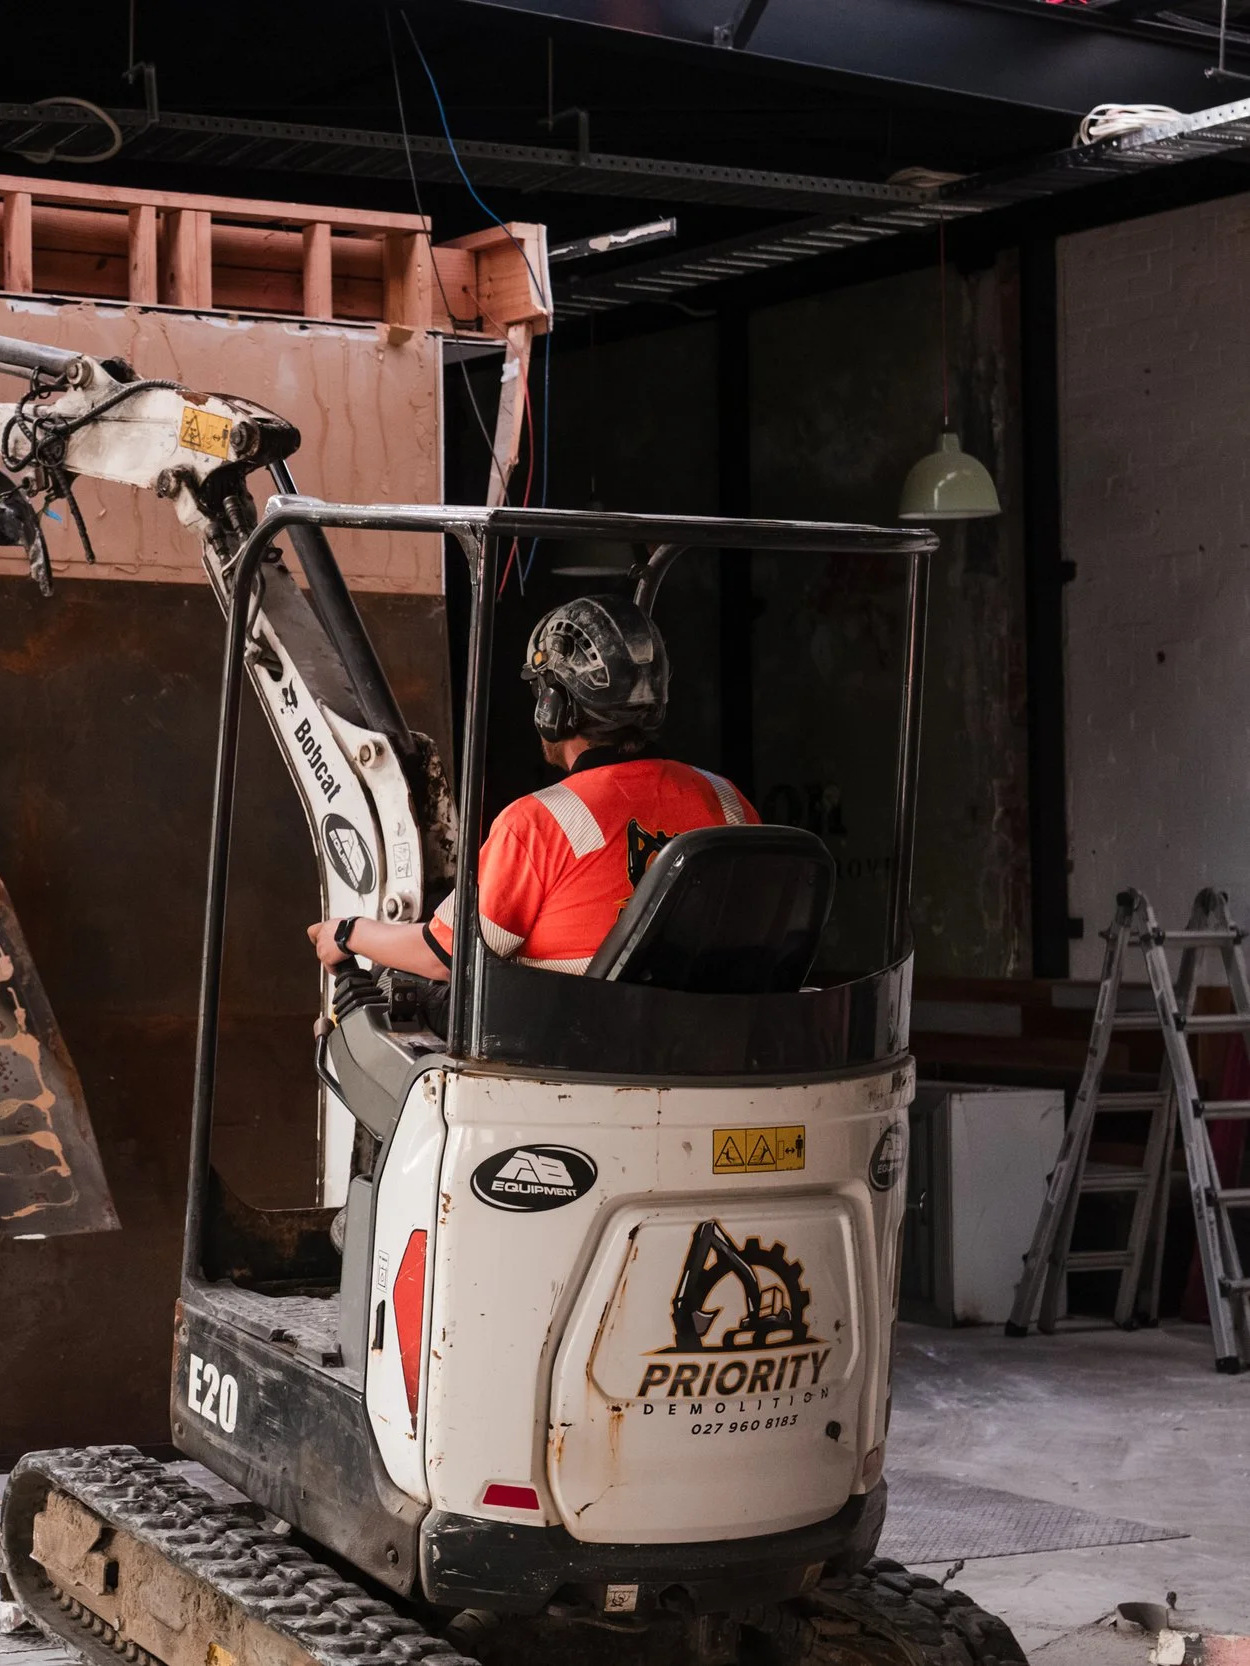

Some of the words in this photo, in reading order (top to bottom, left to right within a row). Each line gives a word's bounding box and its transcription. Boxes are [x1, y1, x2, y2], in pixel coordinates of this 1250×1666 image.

[294, 717, 342, 804] Bobcat
[495, 1149, 574, 1187] AB
[490, 1179, 578, 1197] EQUIPMENT
[635, 1347, 834, 1398] PRIORITY
[187, 1352, 239, 1434] E20
[643, 1386, 830, 1416] DEMOLITION
[691, 1423, 725, 1435] 027
[728, 1419, 760, 1434] 960
[765, 1413, 799, 1429] 8183
